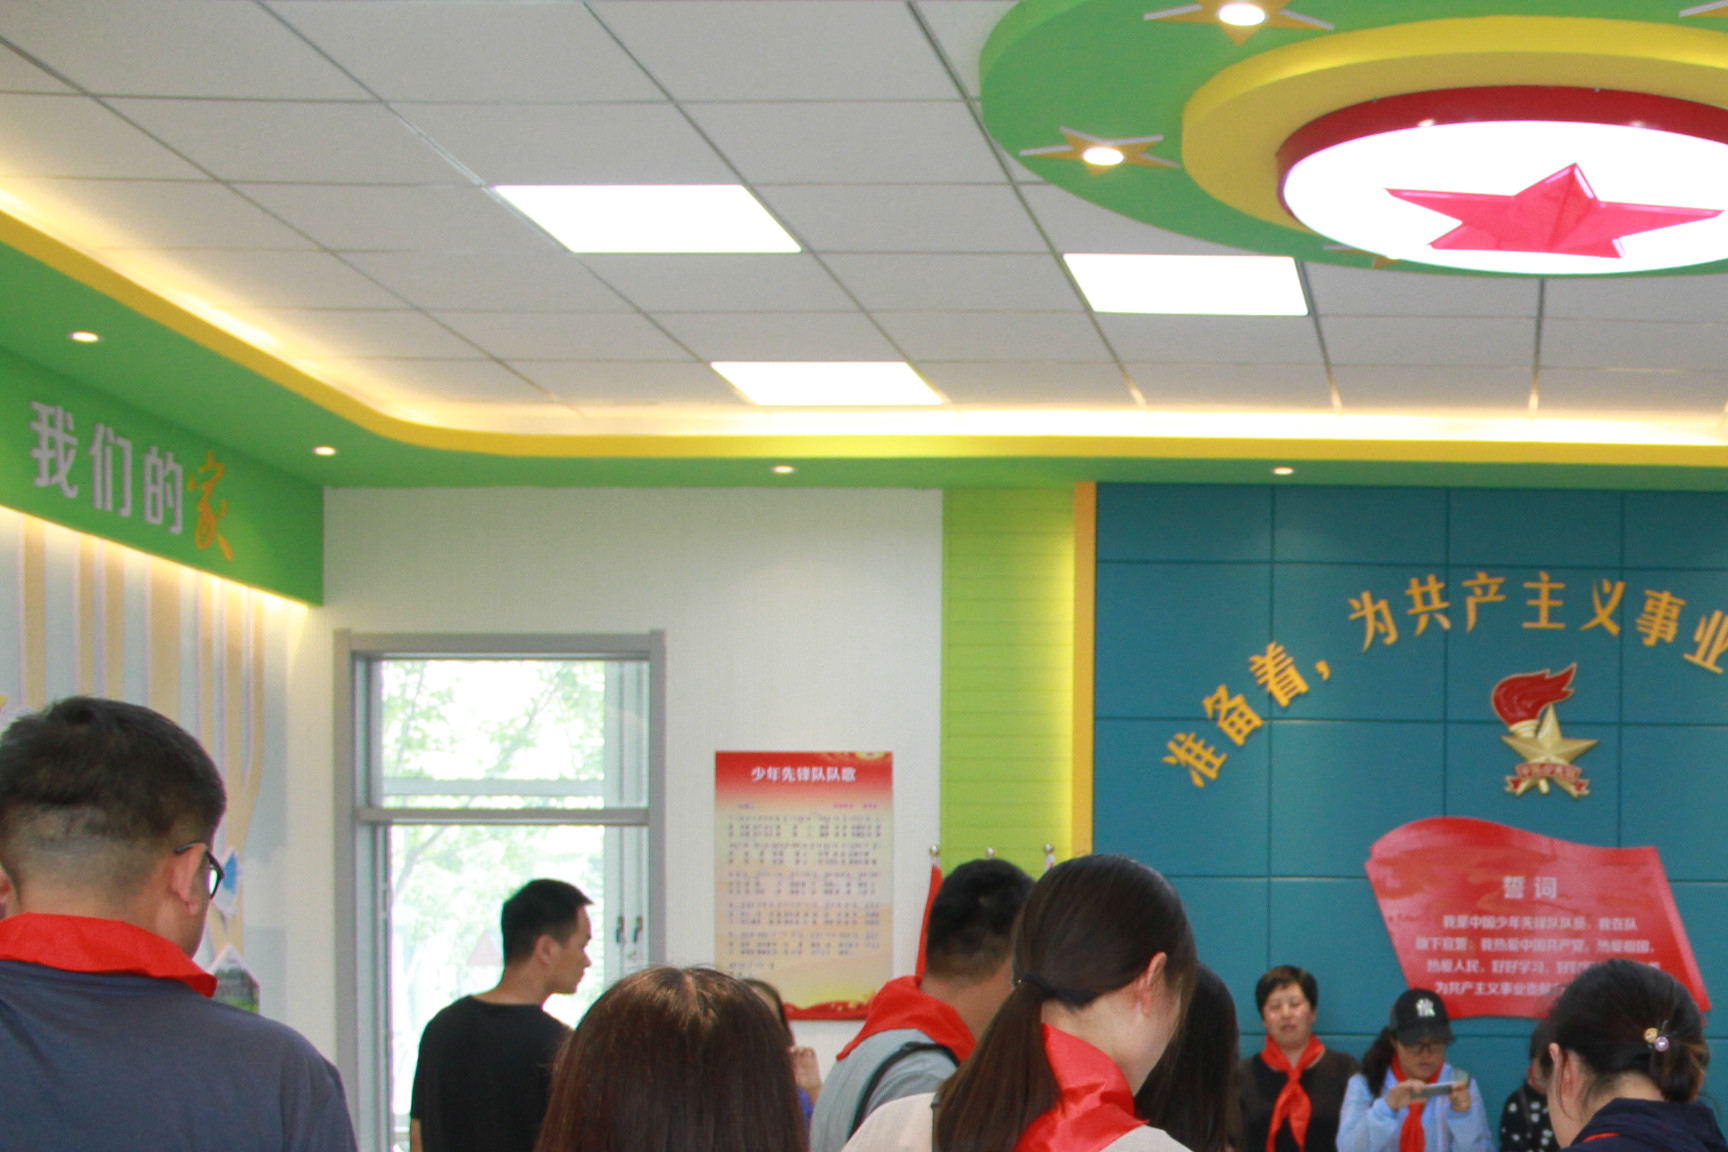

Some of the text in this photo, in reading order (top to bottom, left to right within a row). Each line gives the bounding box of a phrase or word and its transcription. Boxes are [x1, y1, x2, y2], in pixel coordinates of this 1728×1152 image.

[29, 400, 234, 561] 我们的家
[1504, 876, 1557, 899] 誓词
